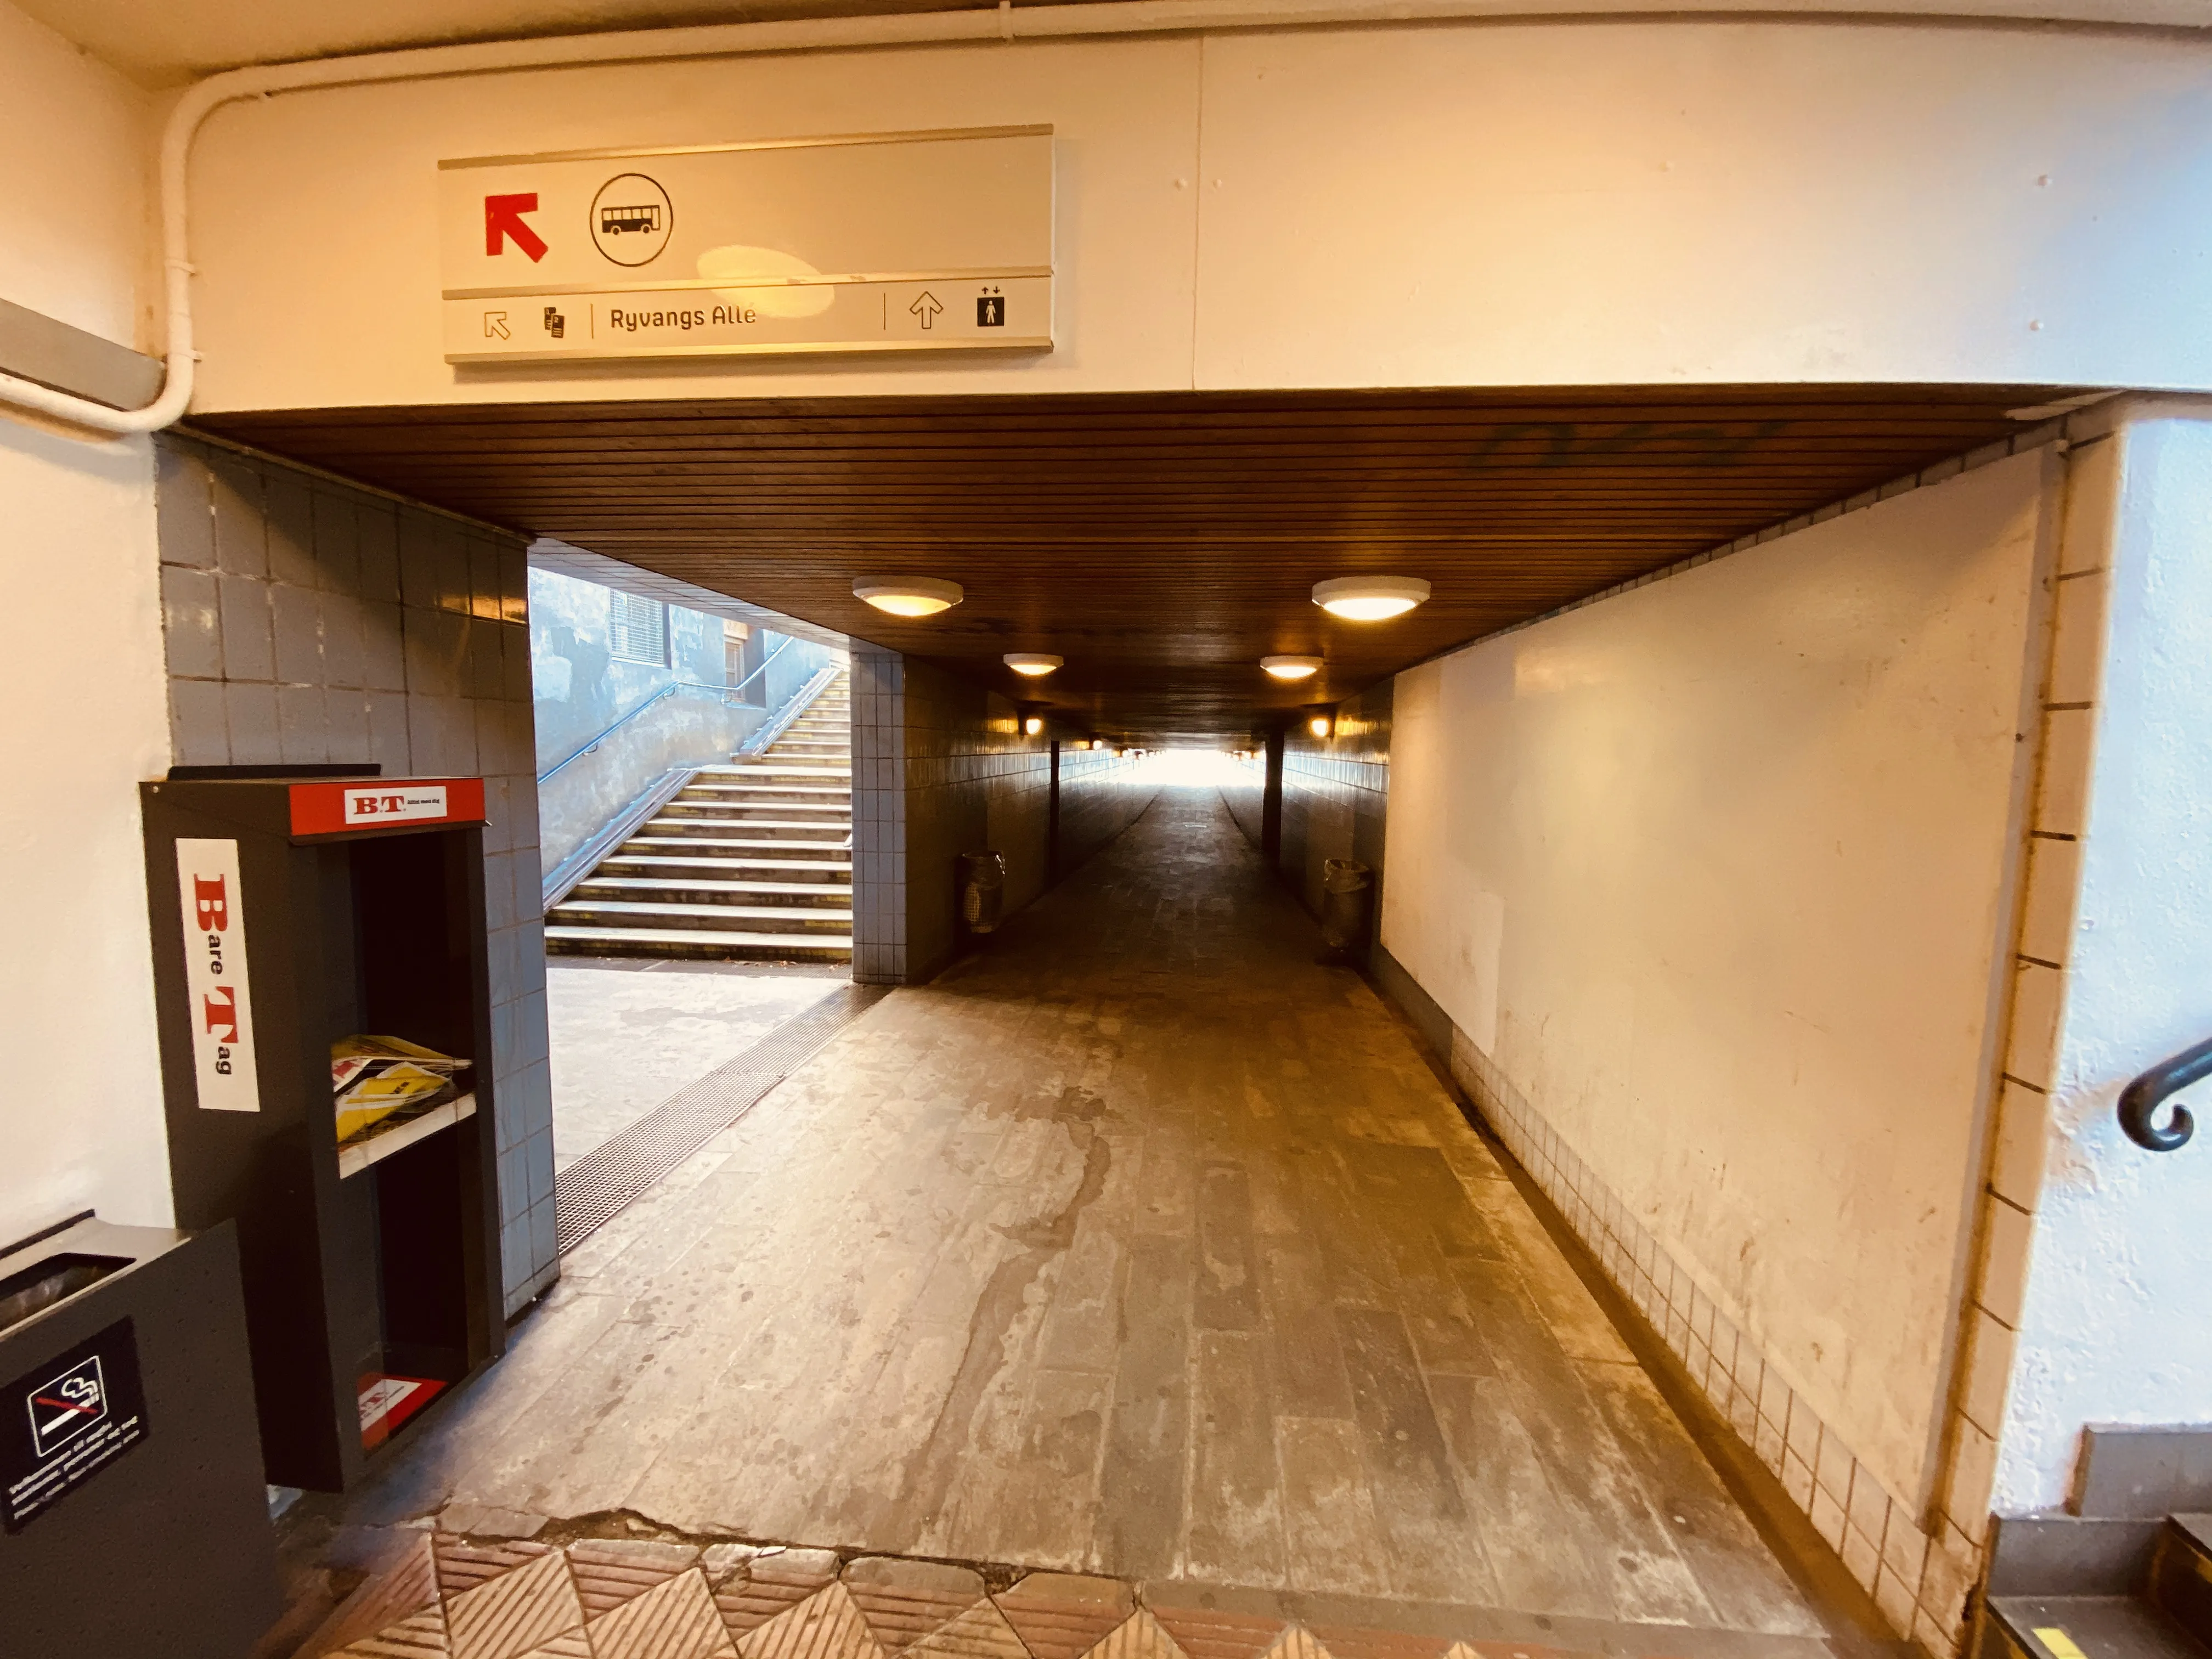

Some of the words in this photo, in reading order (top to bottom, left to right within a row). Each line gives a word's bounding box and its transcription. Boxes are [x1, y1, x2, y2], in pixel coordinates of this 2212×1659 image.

[610, 308, 705, 332] Ryvangs
[194, 873, 228, 975] Bare
[203, 986, 238, 1075] Tag
